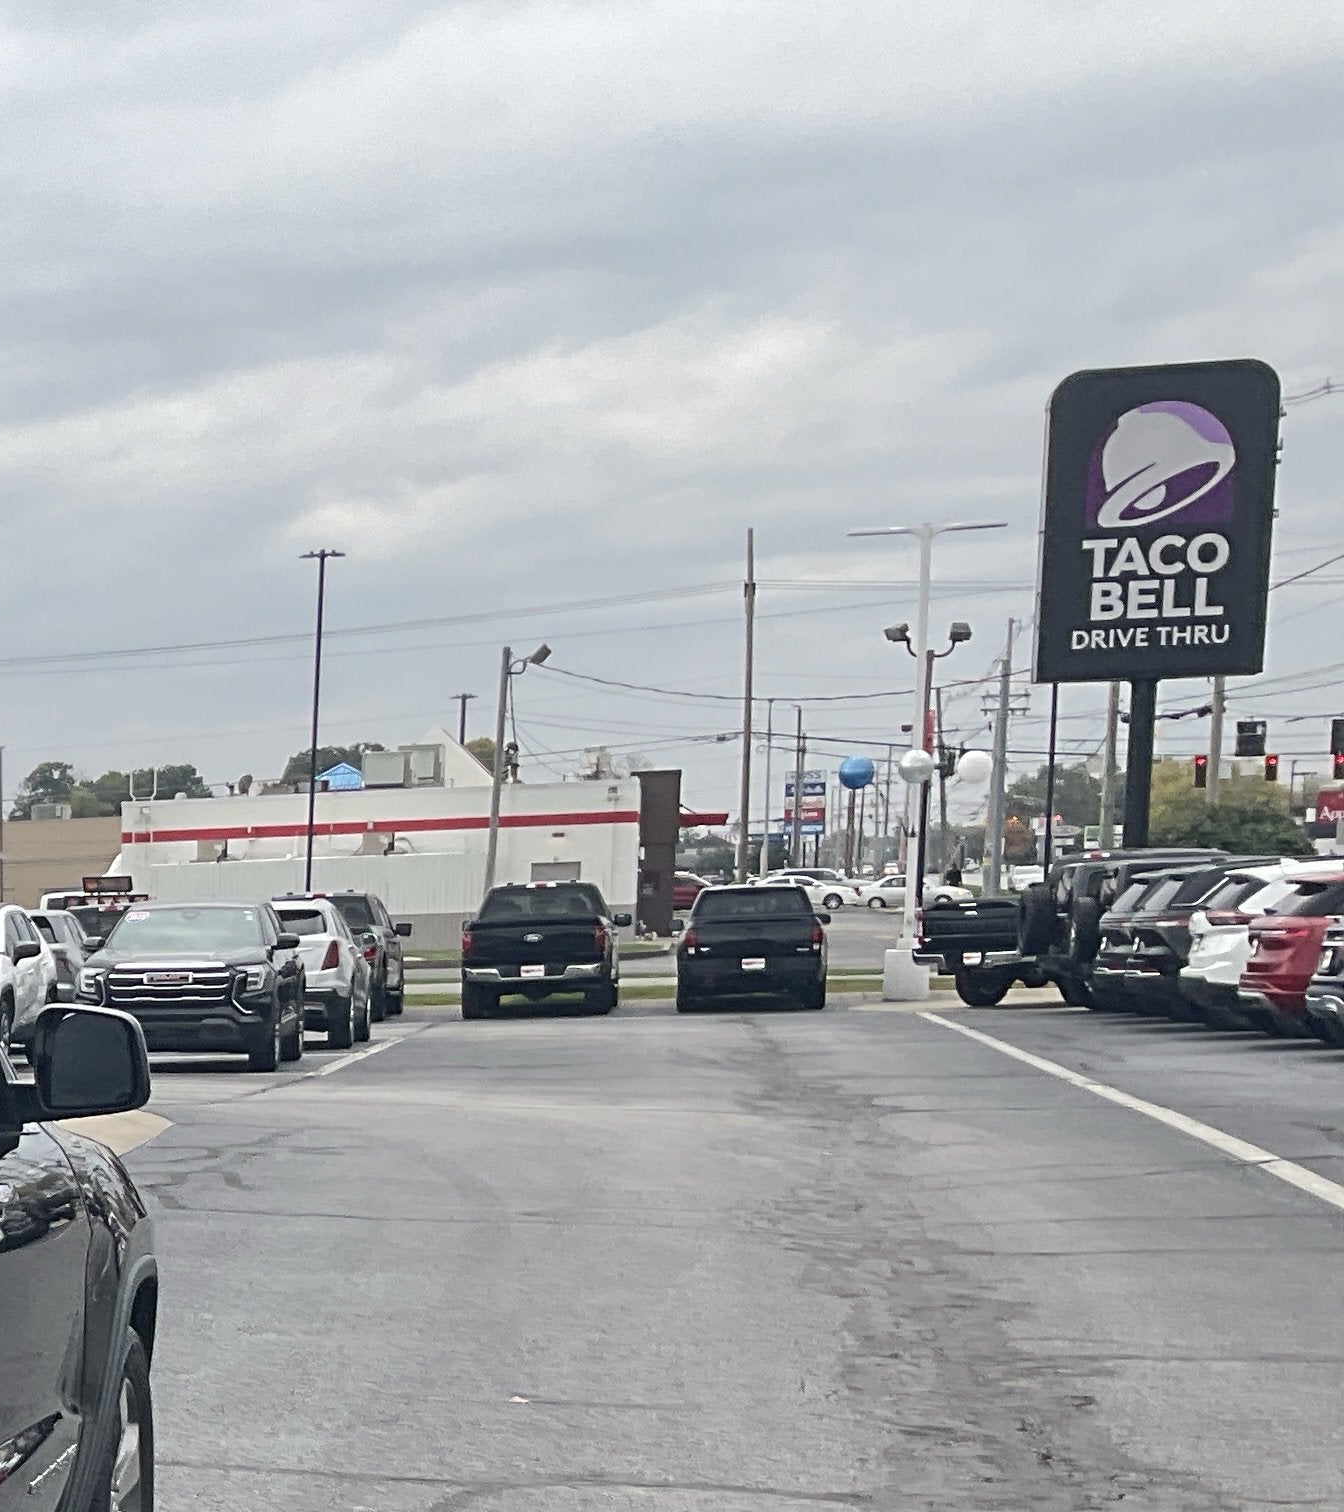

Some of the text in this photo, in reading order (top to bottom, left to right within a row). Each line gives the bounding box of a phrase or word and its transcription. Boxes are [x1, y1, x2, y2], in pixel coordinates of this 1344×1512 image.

[1082, 533, 1230, 578] TACO
[1090, 577, 1224, 621] BELL
[1071, 624, 1230, 650] DRIVE THRU
